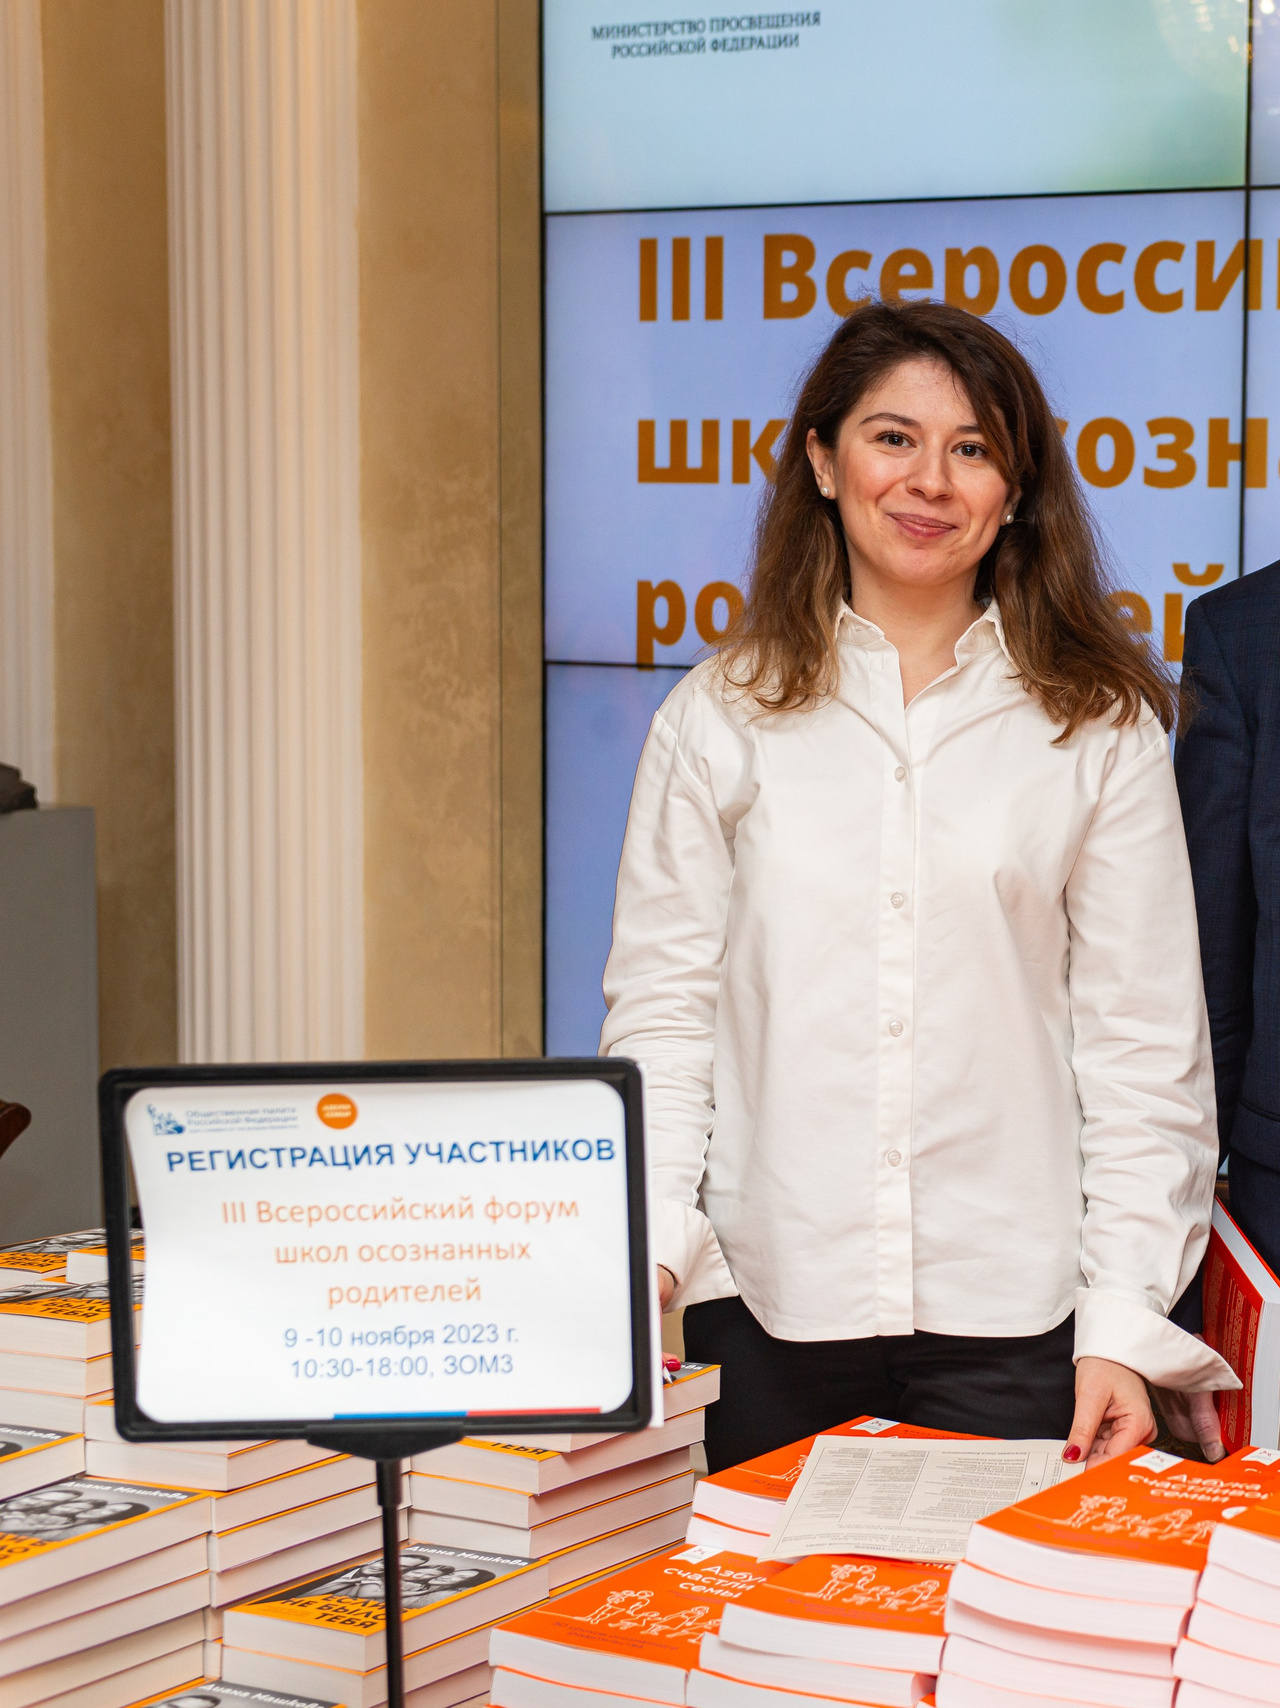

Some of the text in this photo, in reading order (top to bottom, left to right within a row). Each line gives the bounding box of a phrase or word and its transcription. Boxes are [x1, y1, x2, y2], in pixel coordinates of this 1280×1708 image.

[591, 11, 821, 41] МИНИСТЕРСТВО ПРОСВЕЩЕНИЯ
[611, 33, 800, 59] РОССИЙСКОЙ ФЕДЕРАЦИИ
[638, 235, 724, 322] III
[638, 418, 790, 484] шк
[166, 1138, 616, 1173] РЕГИСТРАЦИЯ УЧАСТНИКОВ
[221, 1196, 580, 1228] III Всероссийский форум
[275, 1242, 532, 1264] школ осознанных
[328, 1278, 482, 1310] родителей
[284, 1324, 519, 1351] 9 -10 ноября 2023 г.
[291, 1356, 435, 1379] 10:30-18:00,
[62, 1480, 190, 1501] Диана Машкова
[1166, 1474, 1262, 1492] Азбука
[1150, 1488, 1230, 1503] семьи
[404, 1544, 529, 1567] Диана Машкова
[663, 1566, 756, 1592] счастли
[701, 1565, 768, 1583] Азбу
[313, 1612, 379, 1630] ТЕБЯ
[200, 1683, 251, 1699] Диана
